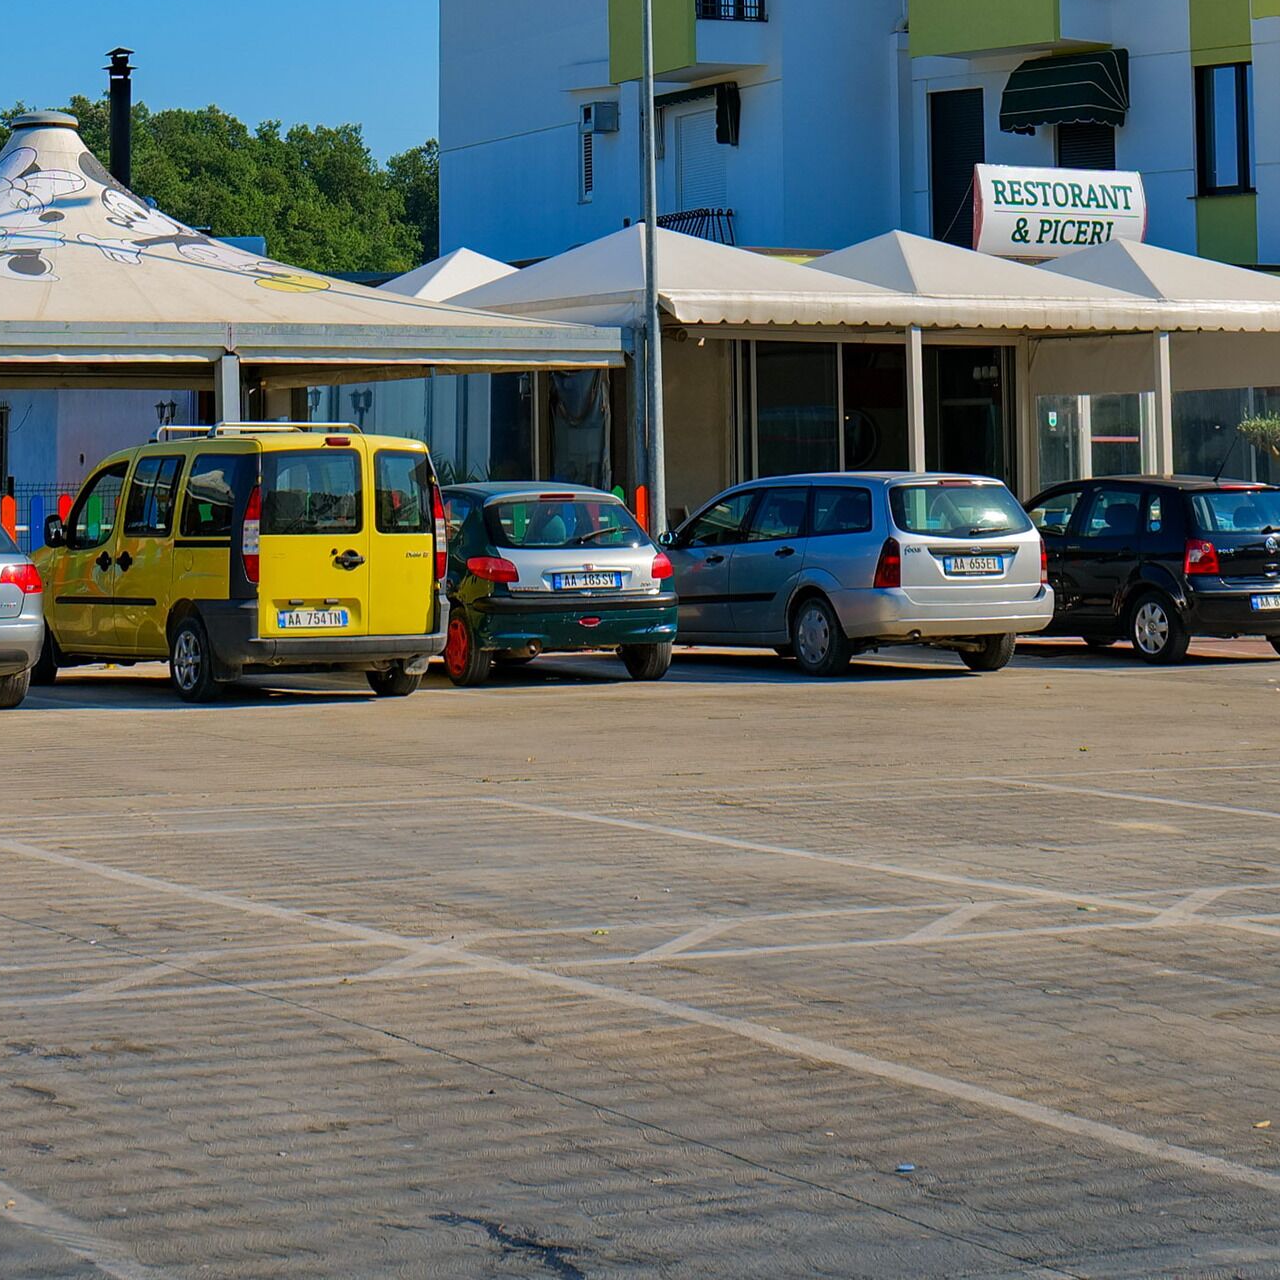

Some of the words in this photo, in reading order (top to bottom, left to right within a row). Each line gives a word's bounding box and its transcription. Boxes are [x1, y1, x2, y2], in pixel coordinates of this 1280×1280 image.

[991, 179, 1133, 211] RESTORANT
[1011, 218, 1030, 244] &
[1036, 219, 1114, 246] PICERI
[953, 558, 966, 570] AA
[564, 575, 577, 587] AA
[583, 573, 615, 586] 183SV
[288, 613, 302, 626] AA
[307, 612, 341, 626] 754TN
